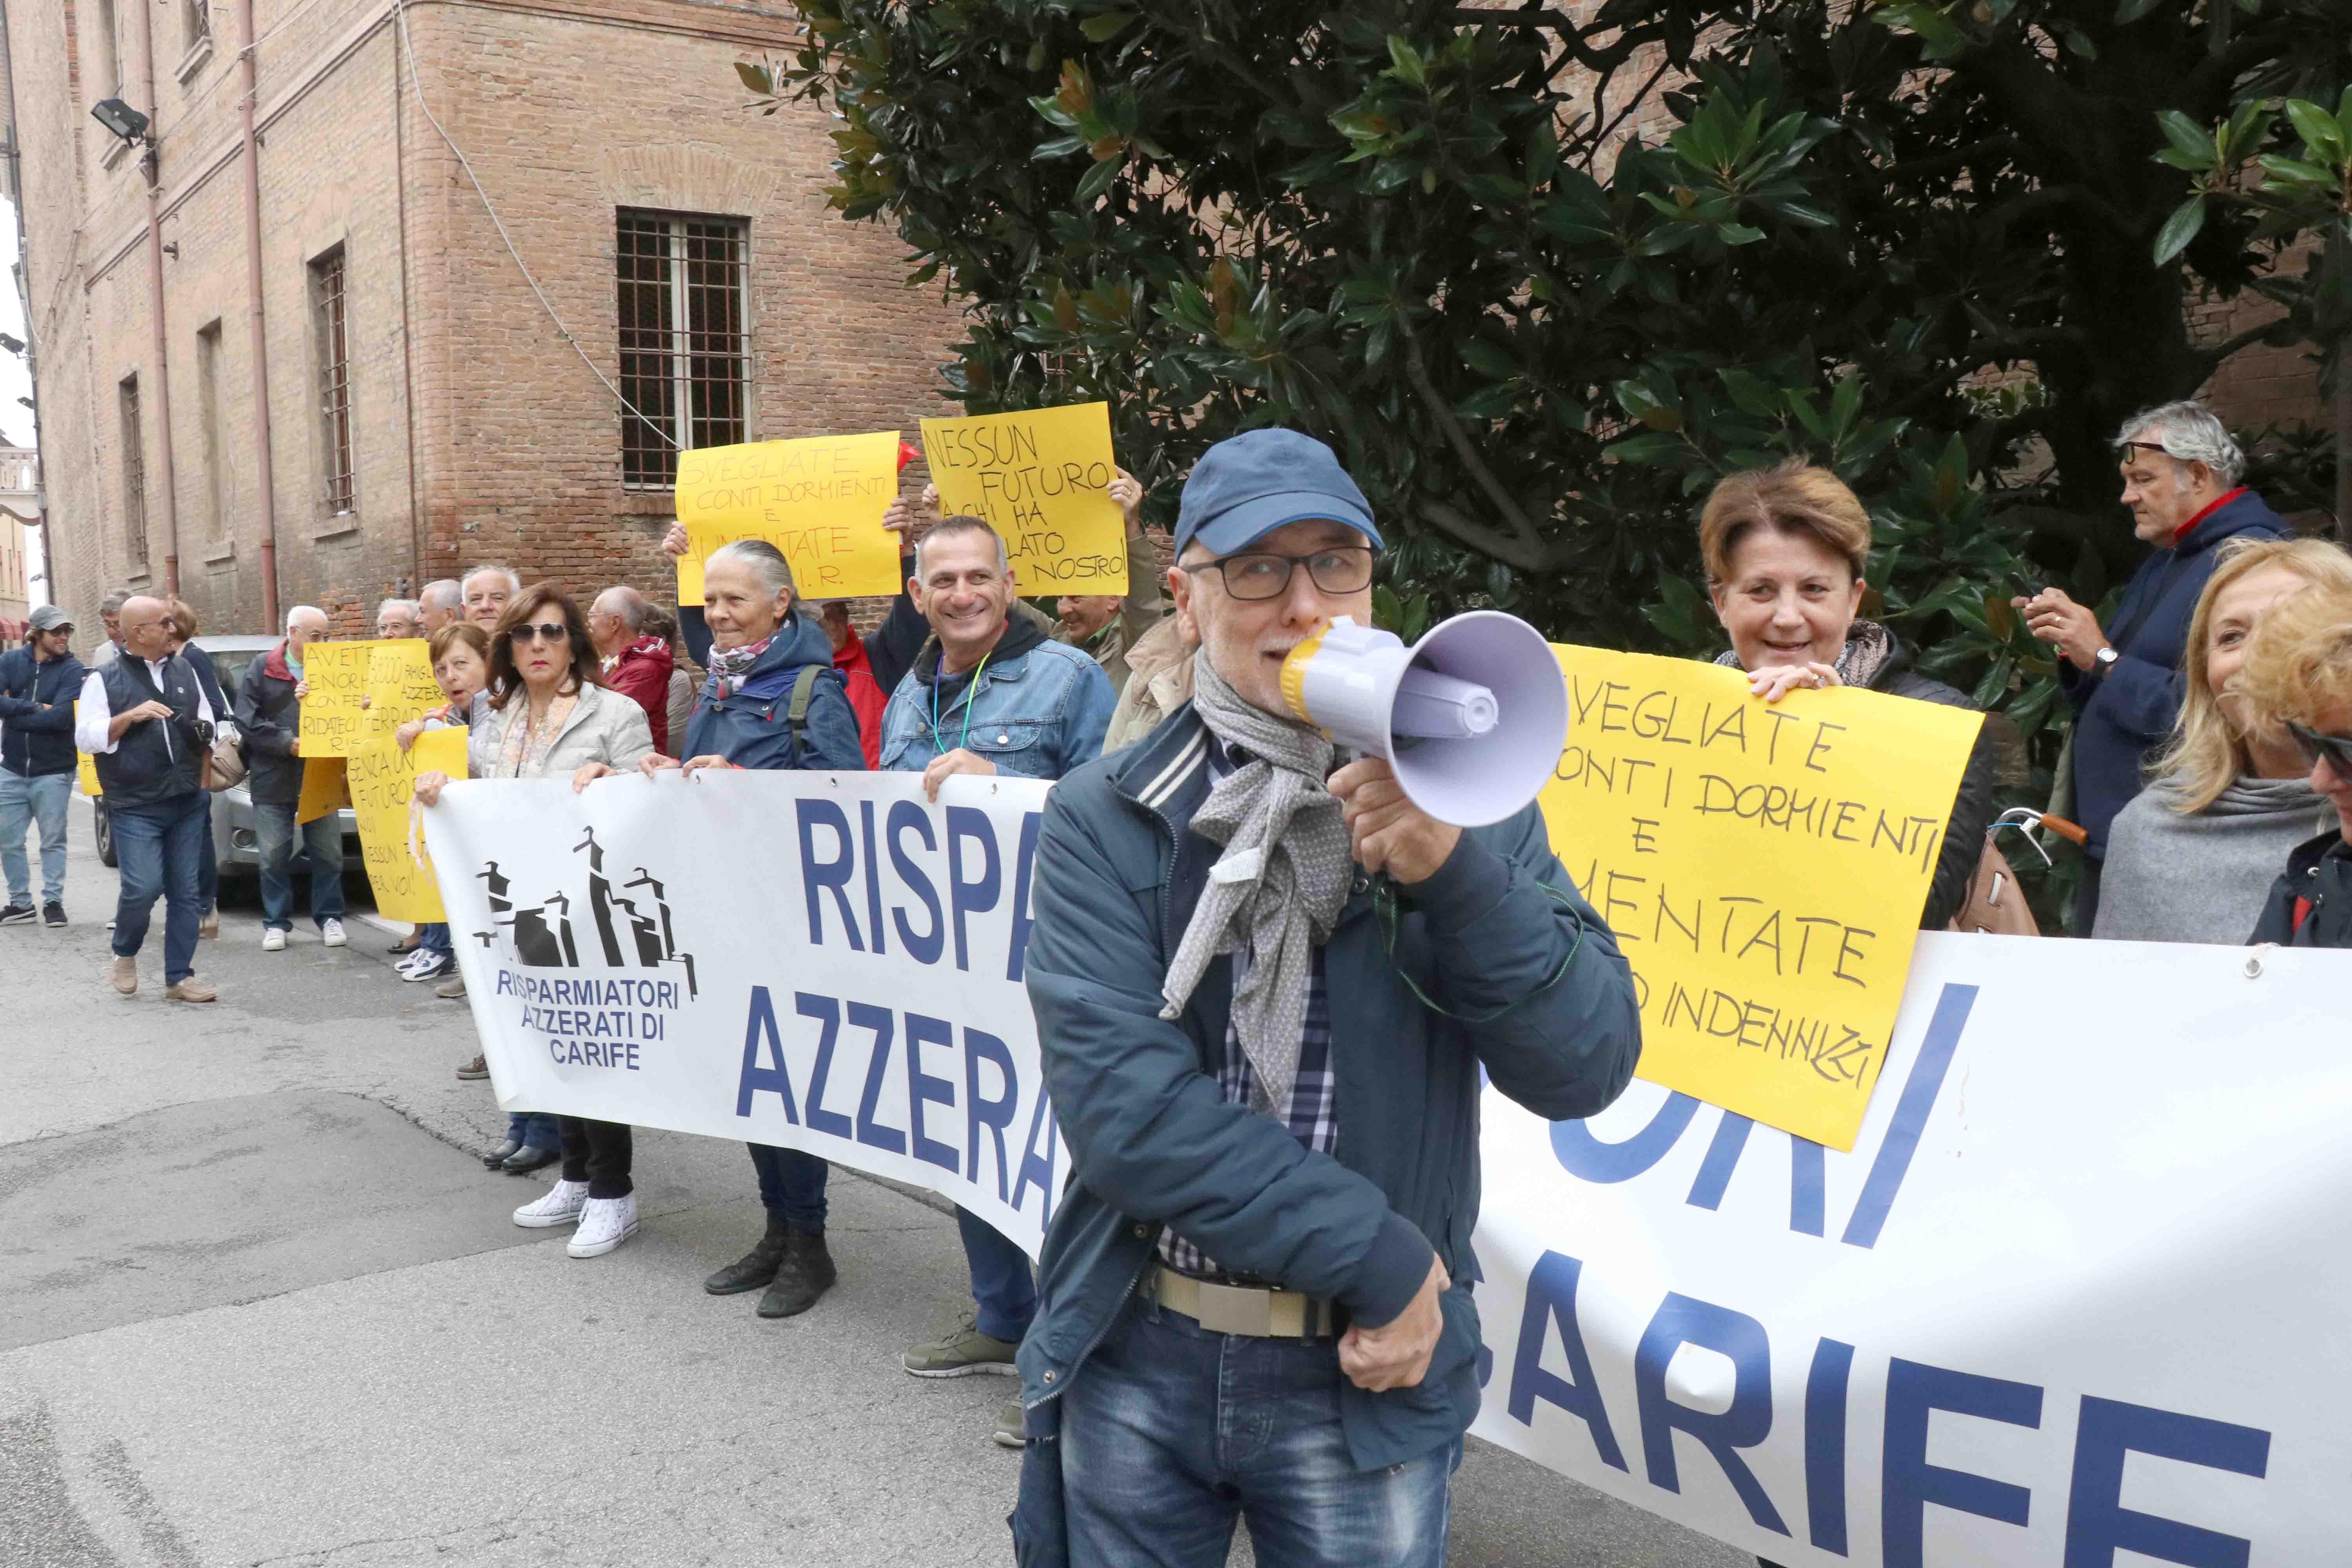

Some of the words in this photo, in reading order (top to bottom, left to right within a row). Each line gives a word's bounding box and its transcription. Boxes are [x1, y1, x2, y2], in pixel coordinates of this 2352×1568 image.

[681, 447, 860, 485] SVEGLIATE
[924, 424, 1038, 471] NESSUN
[697, 486, 762, 510] CONTI
[771, 476, 886, 503] DORMIENTI
[978, 462, 1110, 505] FUTURO
[764, 508, 780, 523] E
[1013, 501, 1048, 530] HA
[1033, 536, 1126, 582] NOSTRO!
[1572, 674, 1847, 773] VEGLIATE
[1555, 746, 1672, 808] ONTI
[1694, 775, 1938, 875] DORMIENTI
[1632, 817, 1660, 853] E
[497, 969, 678, 1010] RISPARMIATORI
[521, 1004, 633, 1038] AZZERATI
[642, 1013, 664, 1041] DI
[550, 1039, 640, 1071] CARIFE
[1470, 1239, 2272, 1568] ARIFE
